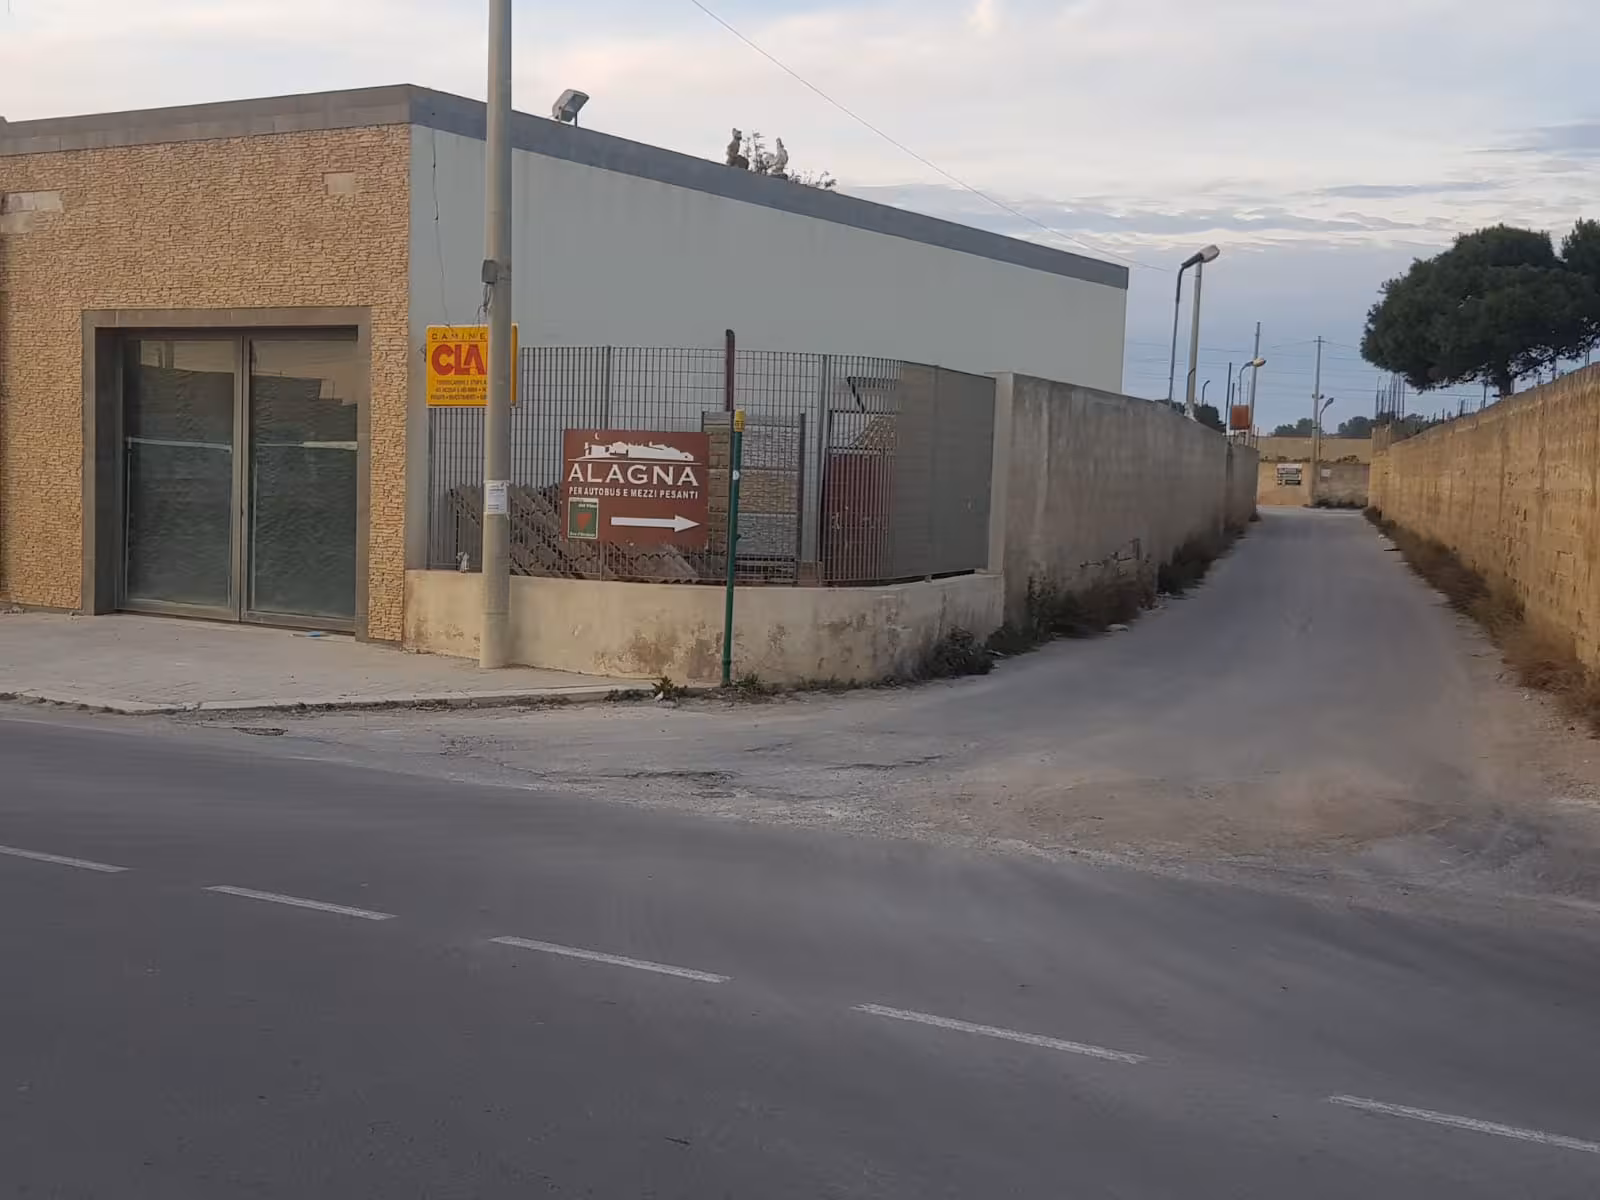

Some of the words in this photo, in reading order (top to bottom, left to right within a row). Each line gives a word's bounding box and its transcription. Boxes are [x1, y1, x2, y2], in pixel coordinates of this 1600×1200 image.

[431, 344, 488, 376] CLA
[568, 463, 699, 487] ALAGNA
[569, 486, 583, 495] PER
[584, 487, 621, 497] AUTOBUS
[623, 488, 629, 497] E
[631, 489, 657, 498] MEZZI
[660, 490, 698, 500] PESANTI
